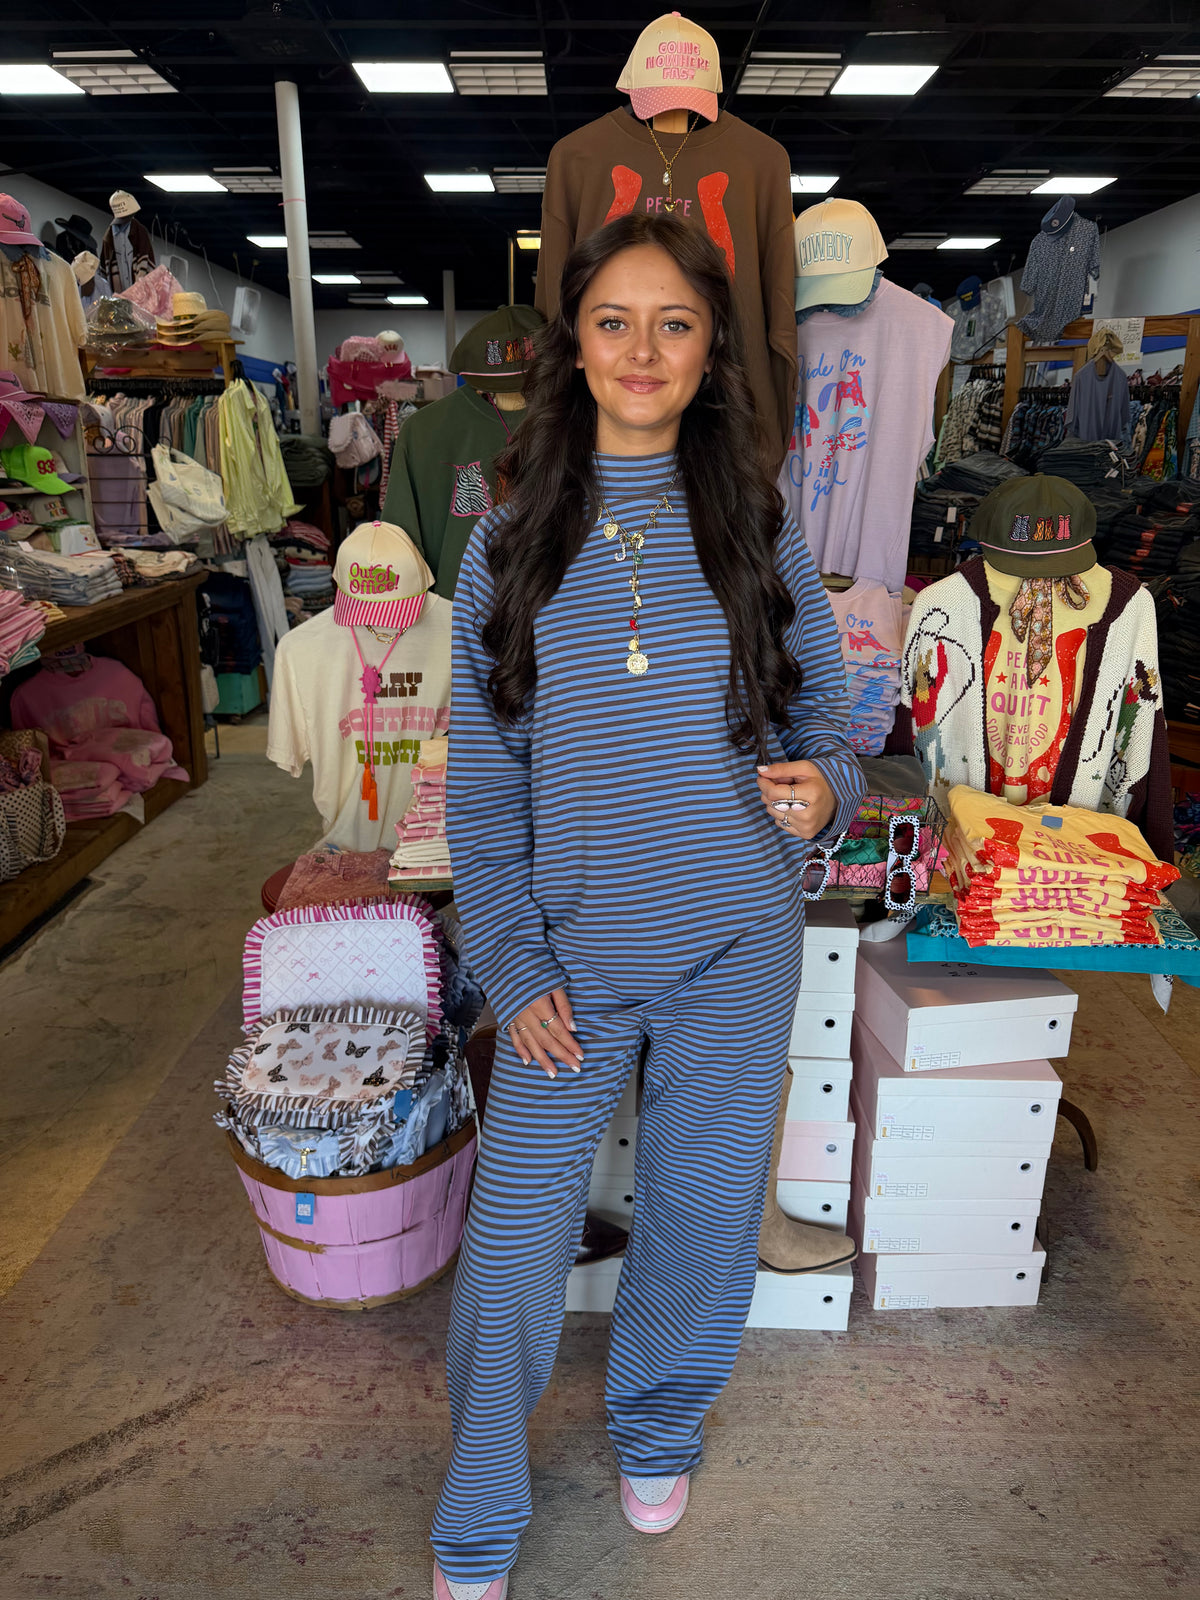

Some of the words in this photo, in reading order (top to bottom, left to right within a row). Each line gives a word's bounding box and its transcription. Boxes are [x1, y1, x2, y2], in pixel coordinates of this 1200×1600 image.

[658, 41, 700, 55] GOING
[646, 54, 710, 71] NOWHERE
[662, 67, 696, 80] FAST
[646, 196, 693, 217] PEE
[799, 230, 853, 269] COWBOY
[839, 349, 866, 370] On
[350, 562, 382, 579] Out
[375, 564, 393, 583] of
[349, 574, 400, 595] Office!
[846, 613, 874, 629] On
[1010, 672, 1030, 691] AN
[991, 691, 1051, 717] QUIET
[338, 706, 450, 741] SOETHING
